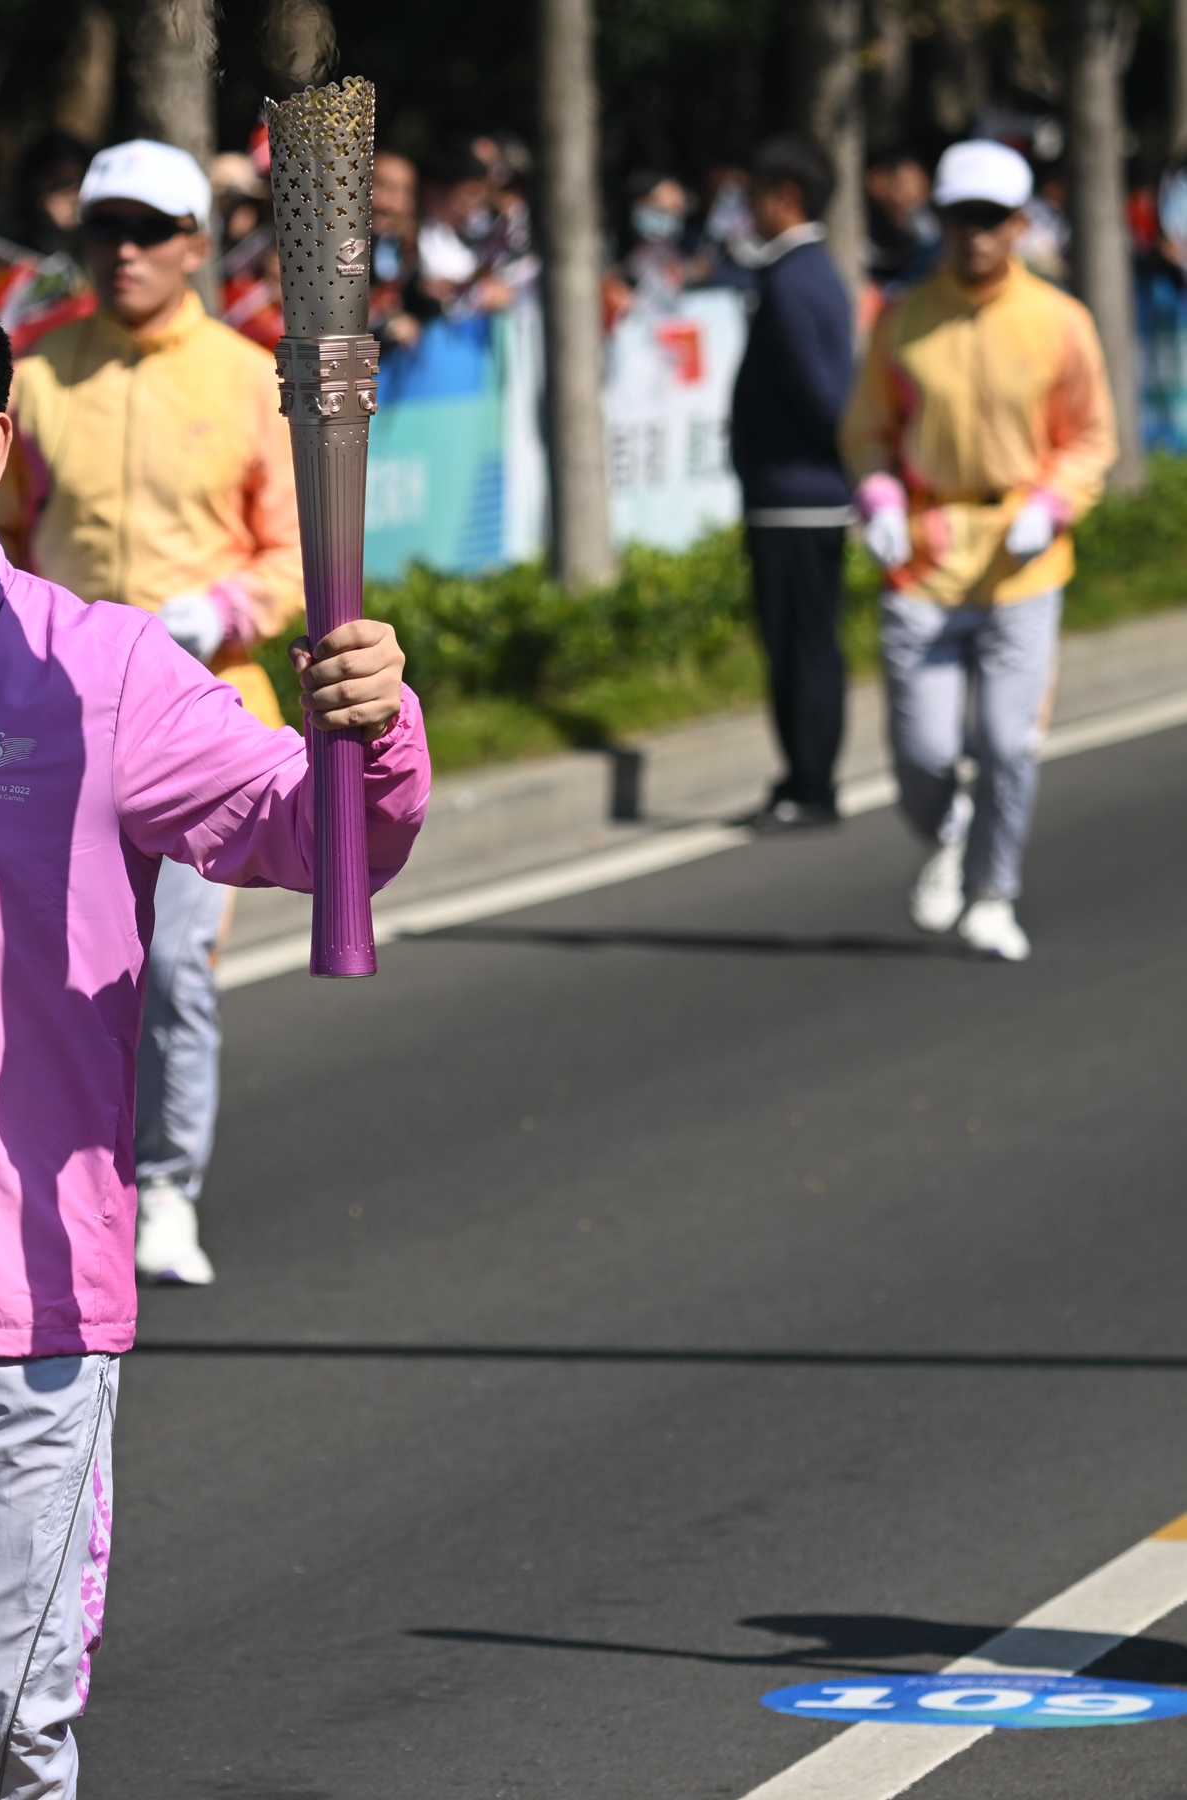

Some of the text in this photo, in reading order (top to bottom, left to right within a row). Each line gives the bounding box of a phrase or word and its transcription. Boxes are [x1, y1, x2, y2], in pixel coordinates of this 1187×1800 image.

[9, 785, 31, 795] 2022
[3, 794, 25, 802] Games
[794, 1686, 1154, 1717] 109
